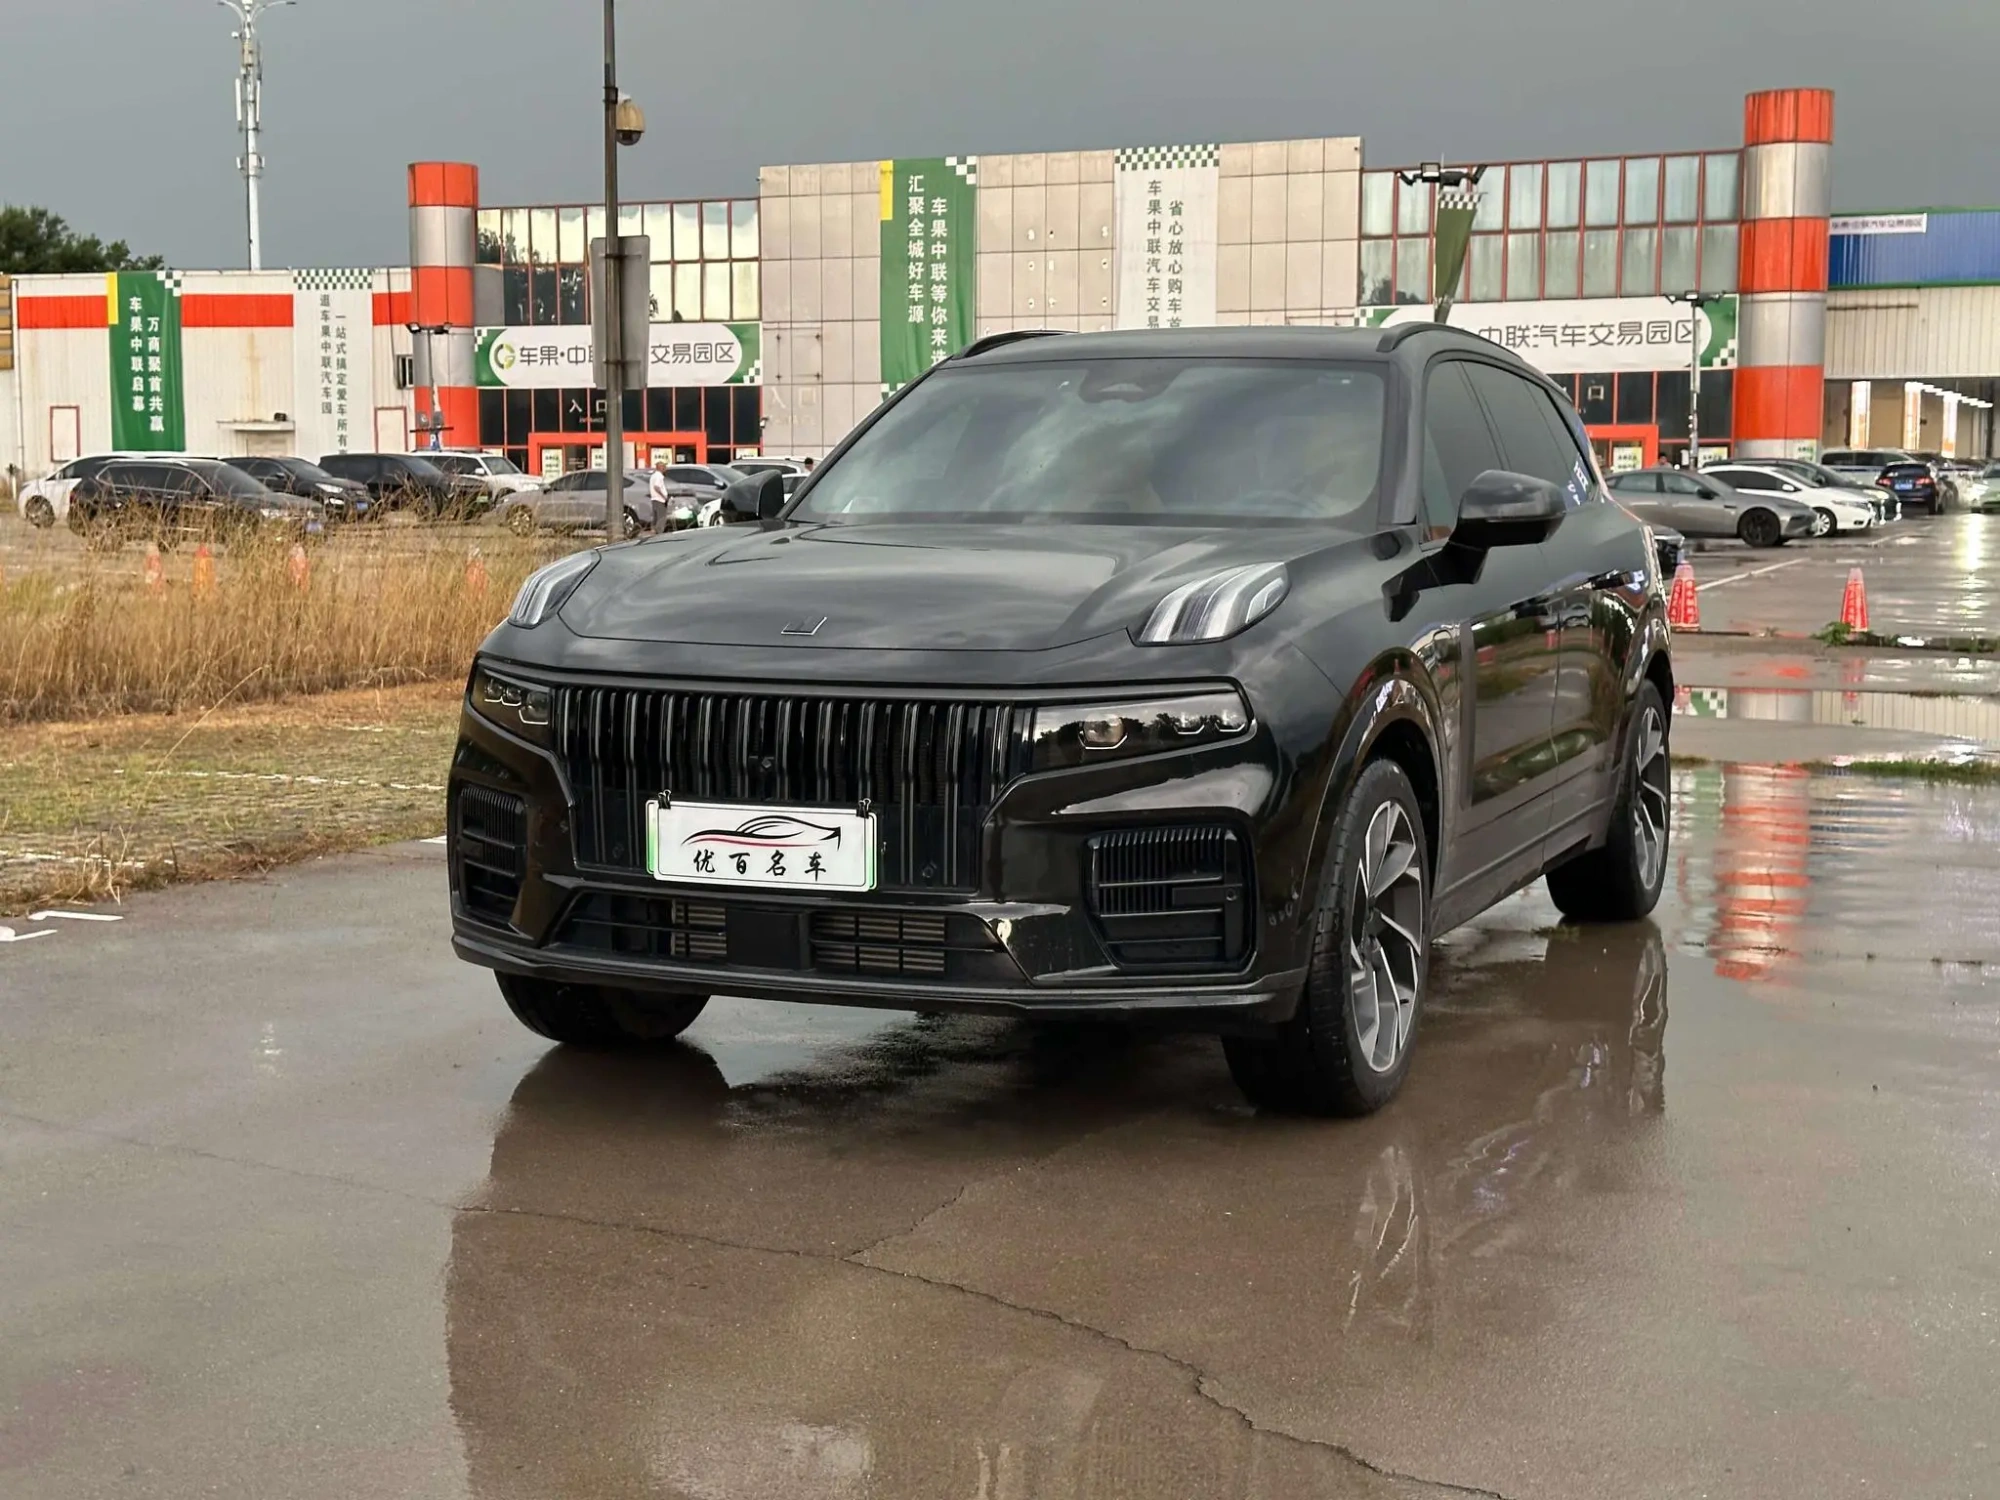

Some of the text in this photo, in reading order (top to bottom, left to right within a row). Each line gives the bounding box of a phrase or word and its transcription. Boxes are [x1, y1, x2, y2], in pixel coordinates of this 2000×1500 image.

[908, 175, 925, 324] 汇聚全城好车源
[129, 297, 145, 412] 车果中联启幕
[569, 398, 607, 413] 入口
[693, 849, 826, 881] 优百名车
